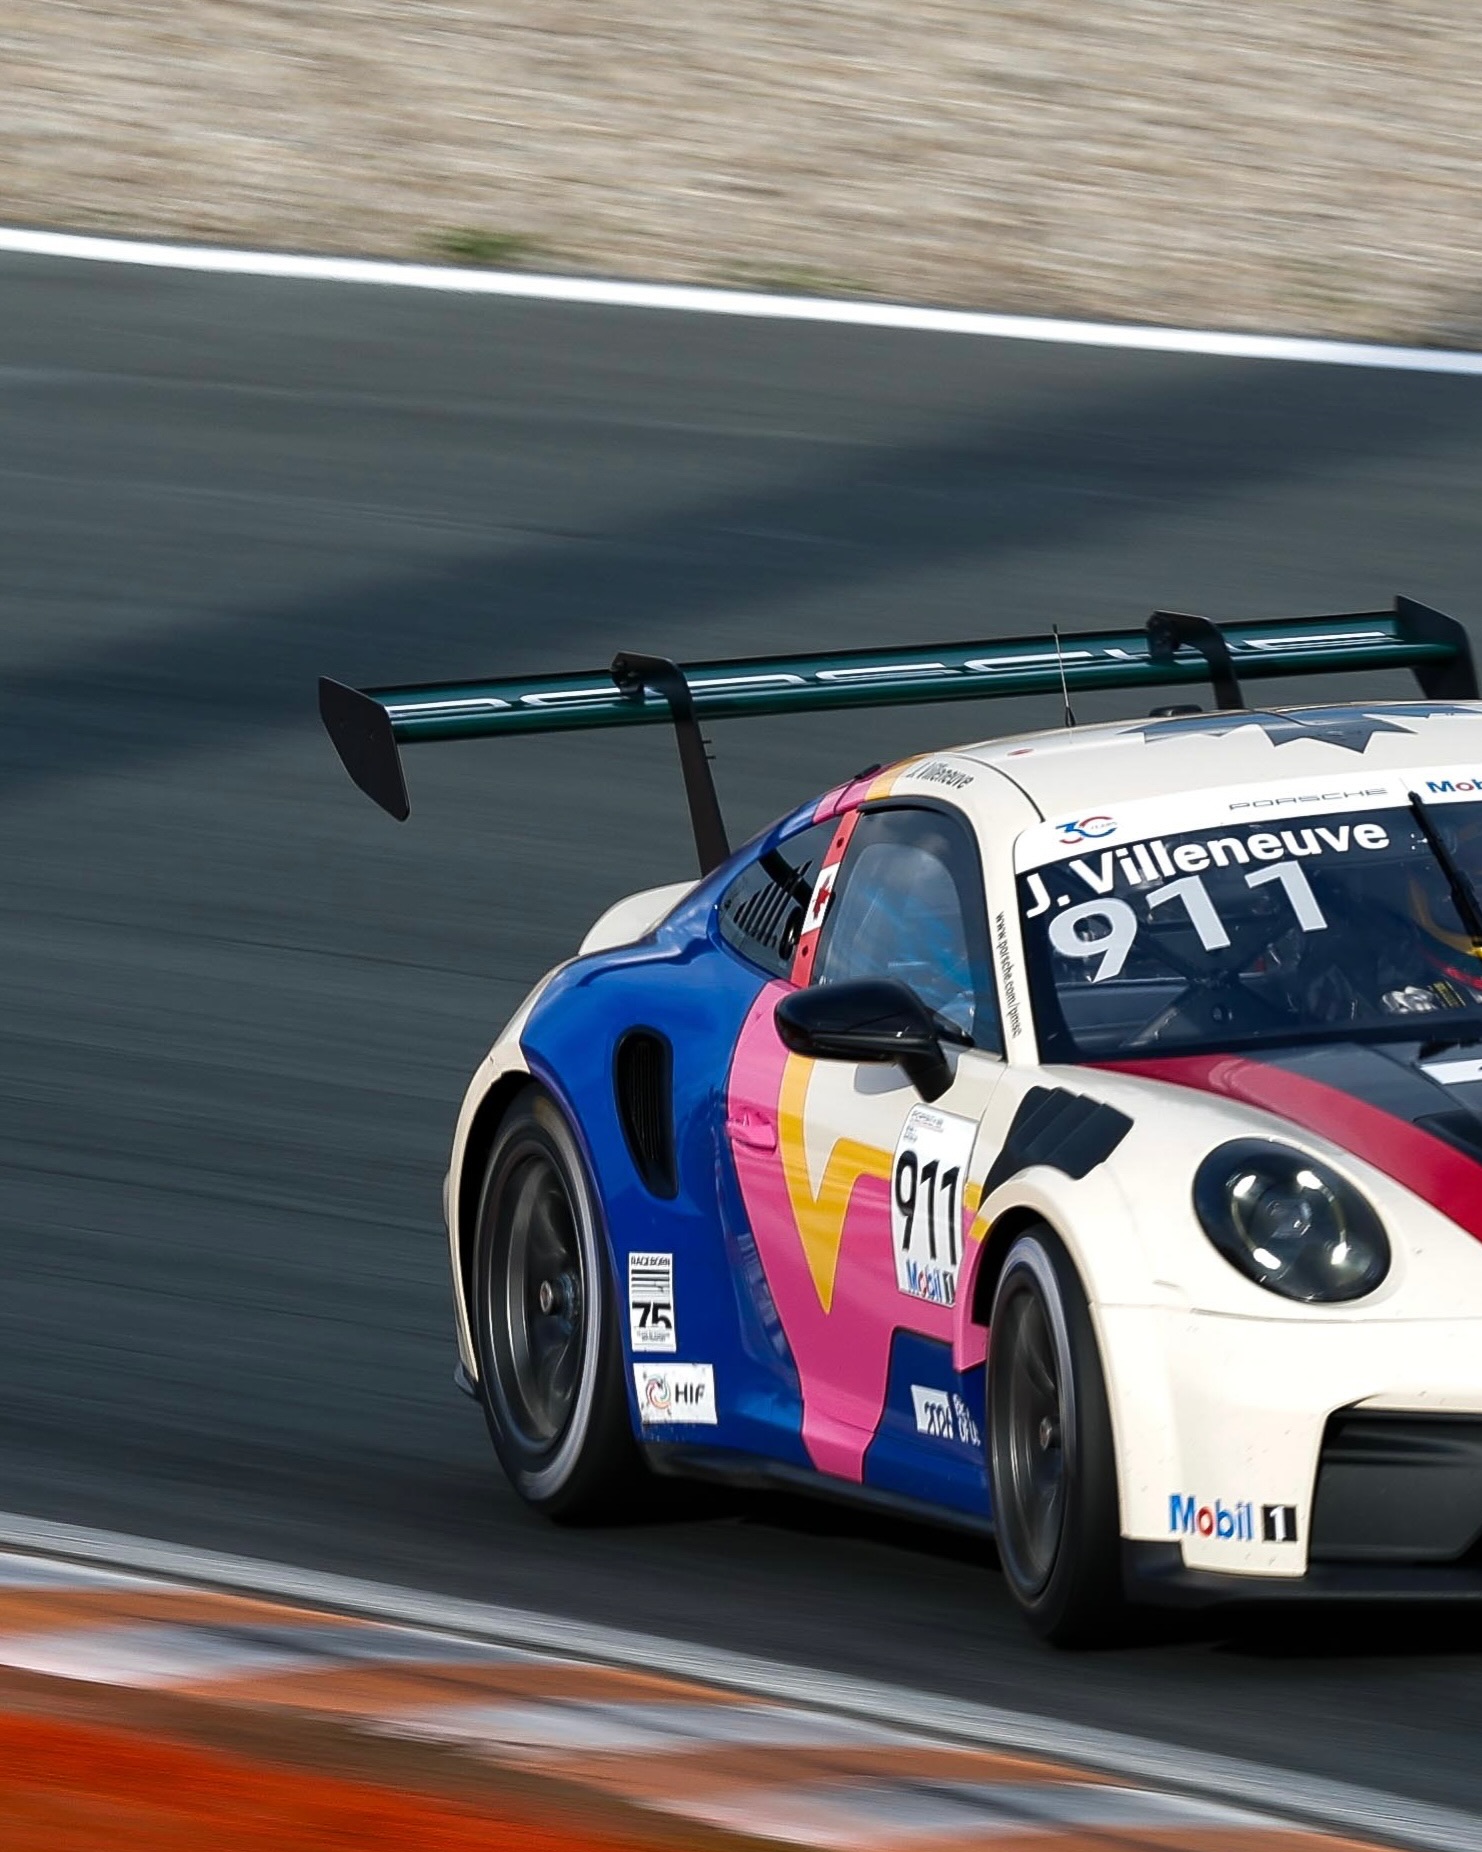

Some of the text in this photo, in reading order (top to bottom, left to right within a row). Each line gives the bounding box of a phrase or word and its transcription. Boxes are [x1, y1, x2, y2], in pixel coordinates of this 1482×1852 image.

[386, 631, 1403, 718] POSCE
[1228, 788, 1388, 811] PORSCHE
[1068, 821, 1391, 894] Villeneuve
[1048, 860, 1328, 983] 911
[895, 1150, 961, 1267] 911
[906, 1258, 943, 1304] Mobil
[632, 1302, 673, 1329] 75
[675, 1382, 706, 1405] HIF
[1169, 1493, 1292, 1542] Mobil 1
